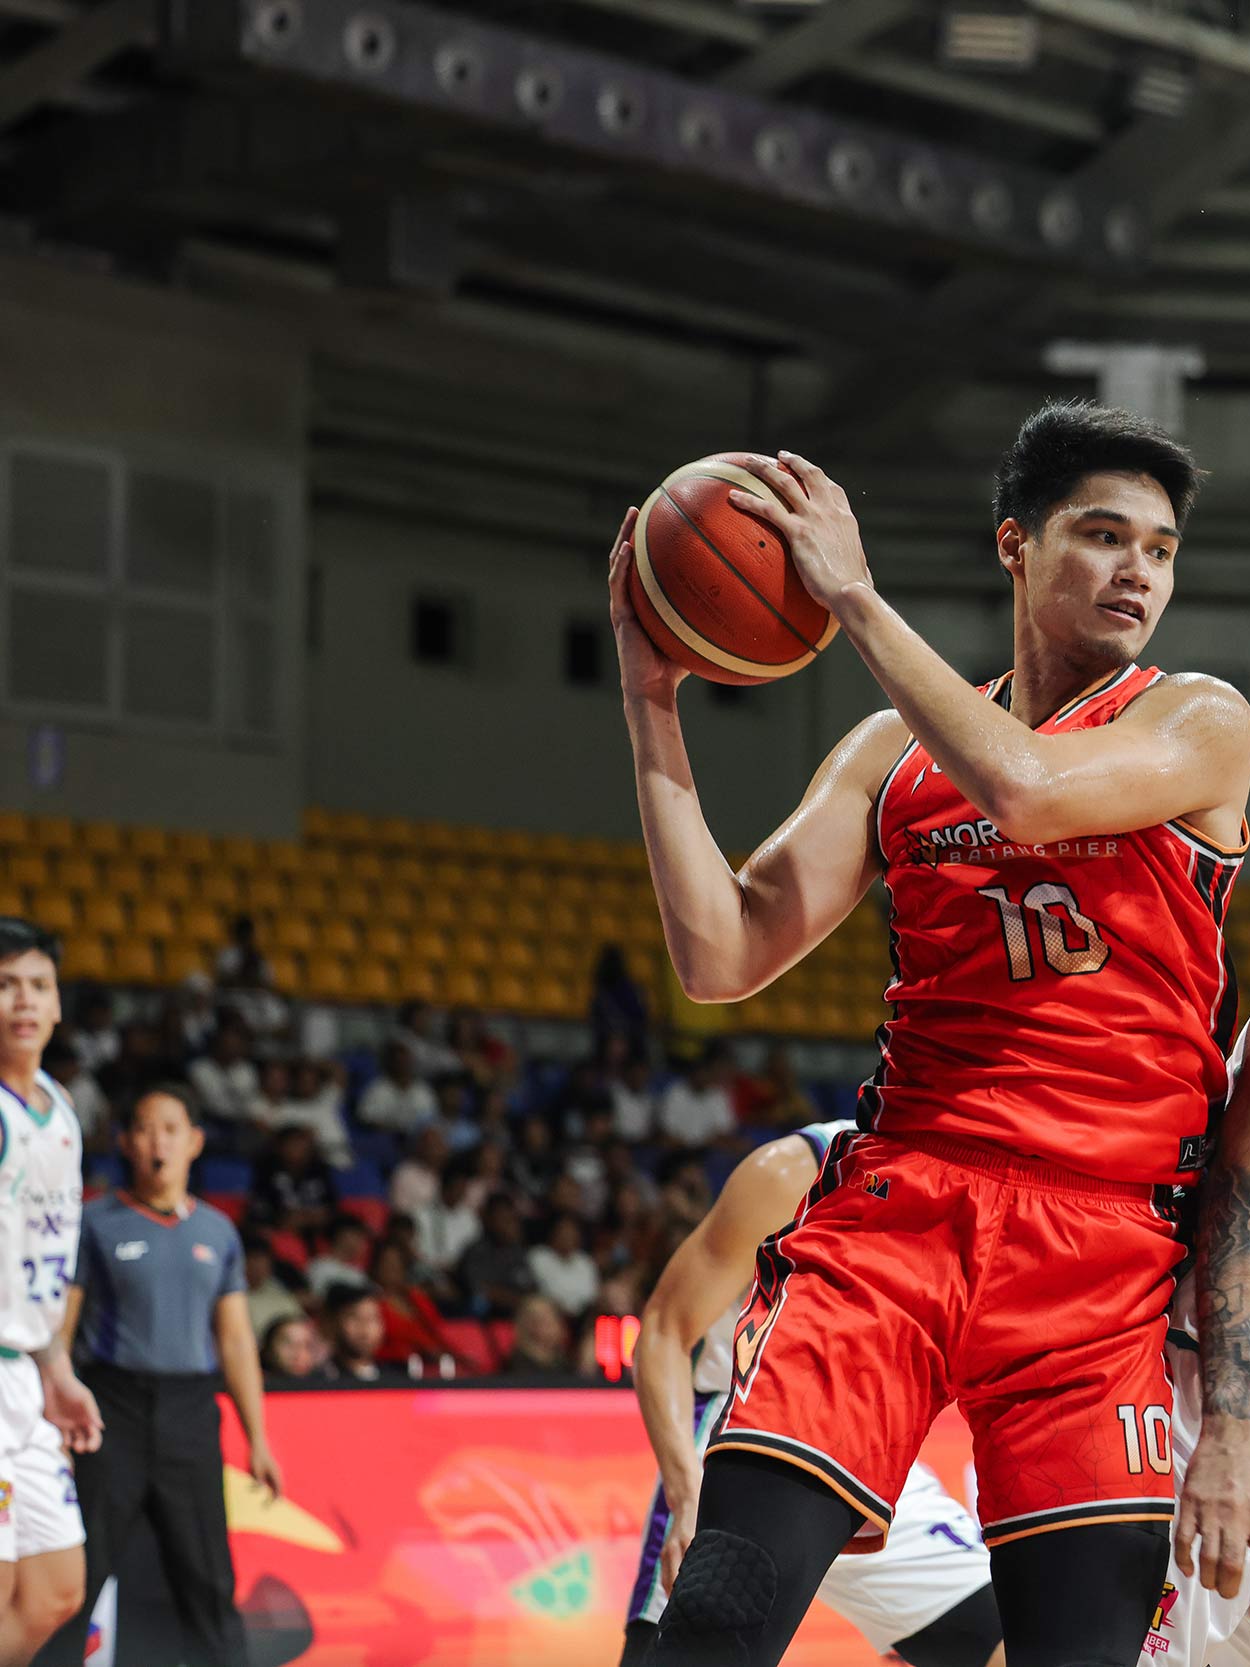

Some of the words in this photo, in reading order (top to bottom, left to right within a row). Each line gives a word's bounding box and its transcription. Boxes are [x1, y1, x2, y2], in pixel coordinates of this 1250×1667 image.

[950, 844, 1045, 863] BATANG
[1057, 841, 1118, 857] PIER
[975, 881, 1112, 981] 10
[847, 1166, 891, 1201] PBA
[1117, 1403, 1173, 1475] 10
